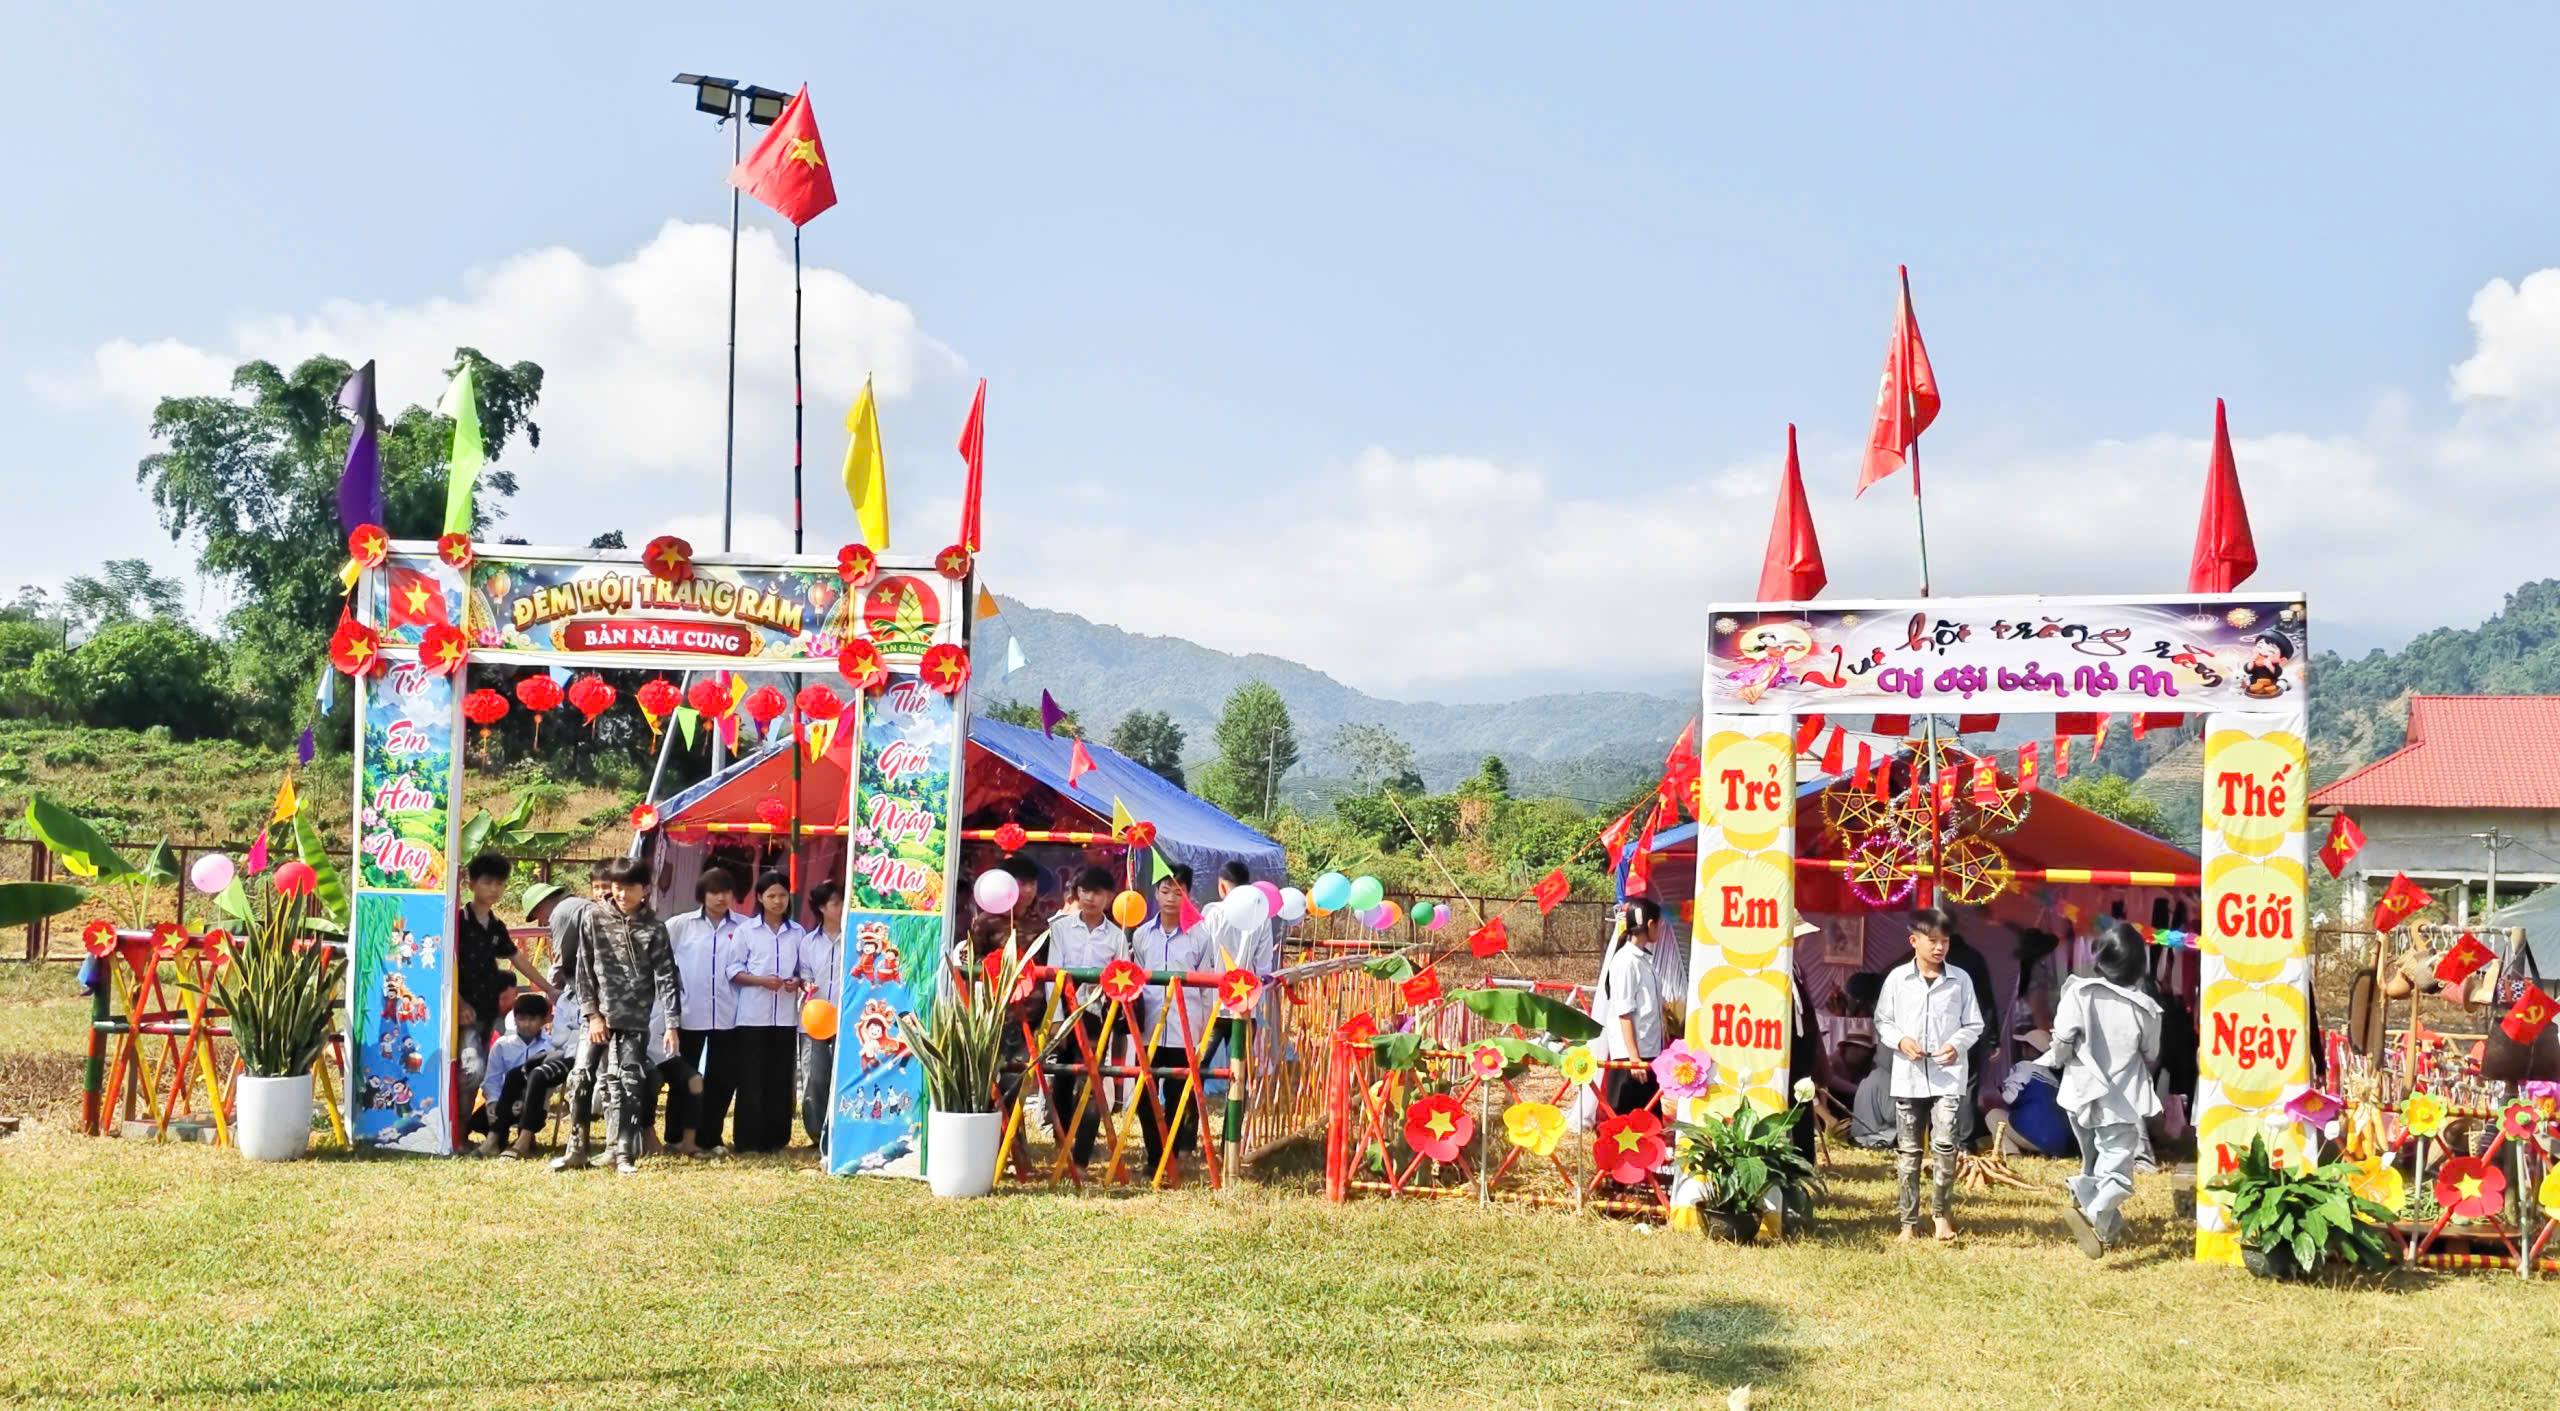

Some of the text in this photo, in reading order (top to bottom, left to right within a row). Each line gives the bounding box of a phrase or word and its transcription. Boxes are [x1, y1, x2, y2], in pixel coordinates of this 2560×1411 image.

[512, 582, 577, 631] ĐÊM
[579, 571, 633, 614] HỘI
[736, 581, 804, 637] RẰM
[584, 623, 739, 651] BẢN NẬM CUNG
[1896, 612, 1971, 656] hội
[1990, 616, 2132, 657] trăng
[890, 682, 931, 713] Thế
[1877, 666, 1924, 699] Chi
[1934, 664, 1987, 700] đội
[1998, 661, 2069, 698] bản
[2129, 665, 2179, 697] An
[388, 720, 428, 754] Em
[880, 742, 928, 781] Giới
[376, 776, 431, 810] Hôm
[1721, 763, 1781, 812] Trẻ
[2217, 764, 2292, 818] Thế
[870, 796, 933, 843] Ngày
[377, 834, 430, 880] Nay
[871, 855, 926, 889] Mai
[1721, 886, 1779, 929] Em
[2216, 891, 2294, 940] Giới
[1711, 1003, 1782, 1050] Hôm
[2212, 1012, 2297, 1070] Ngày
